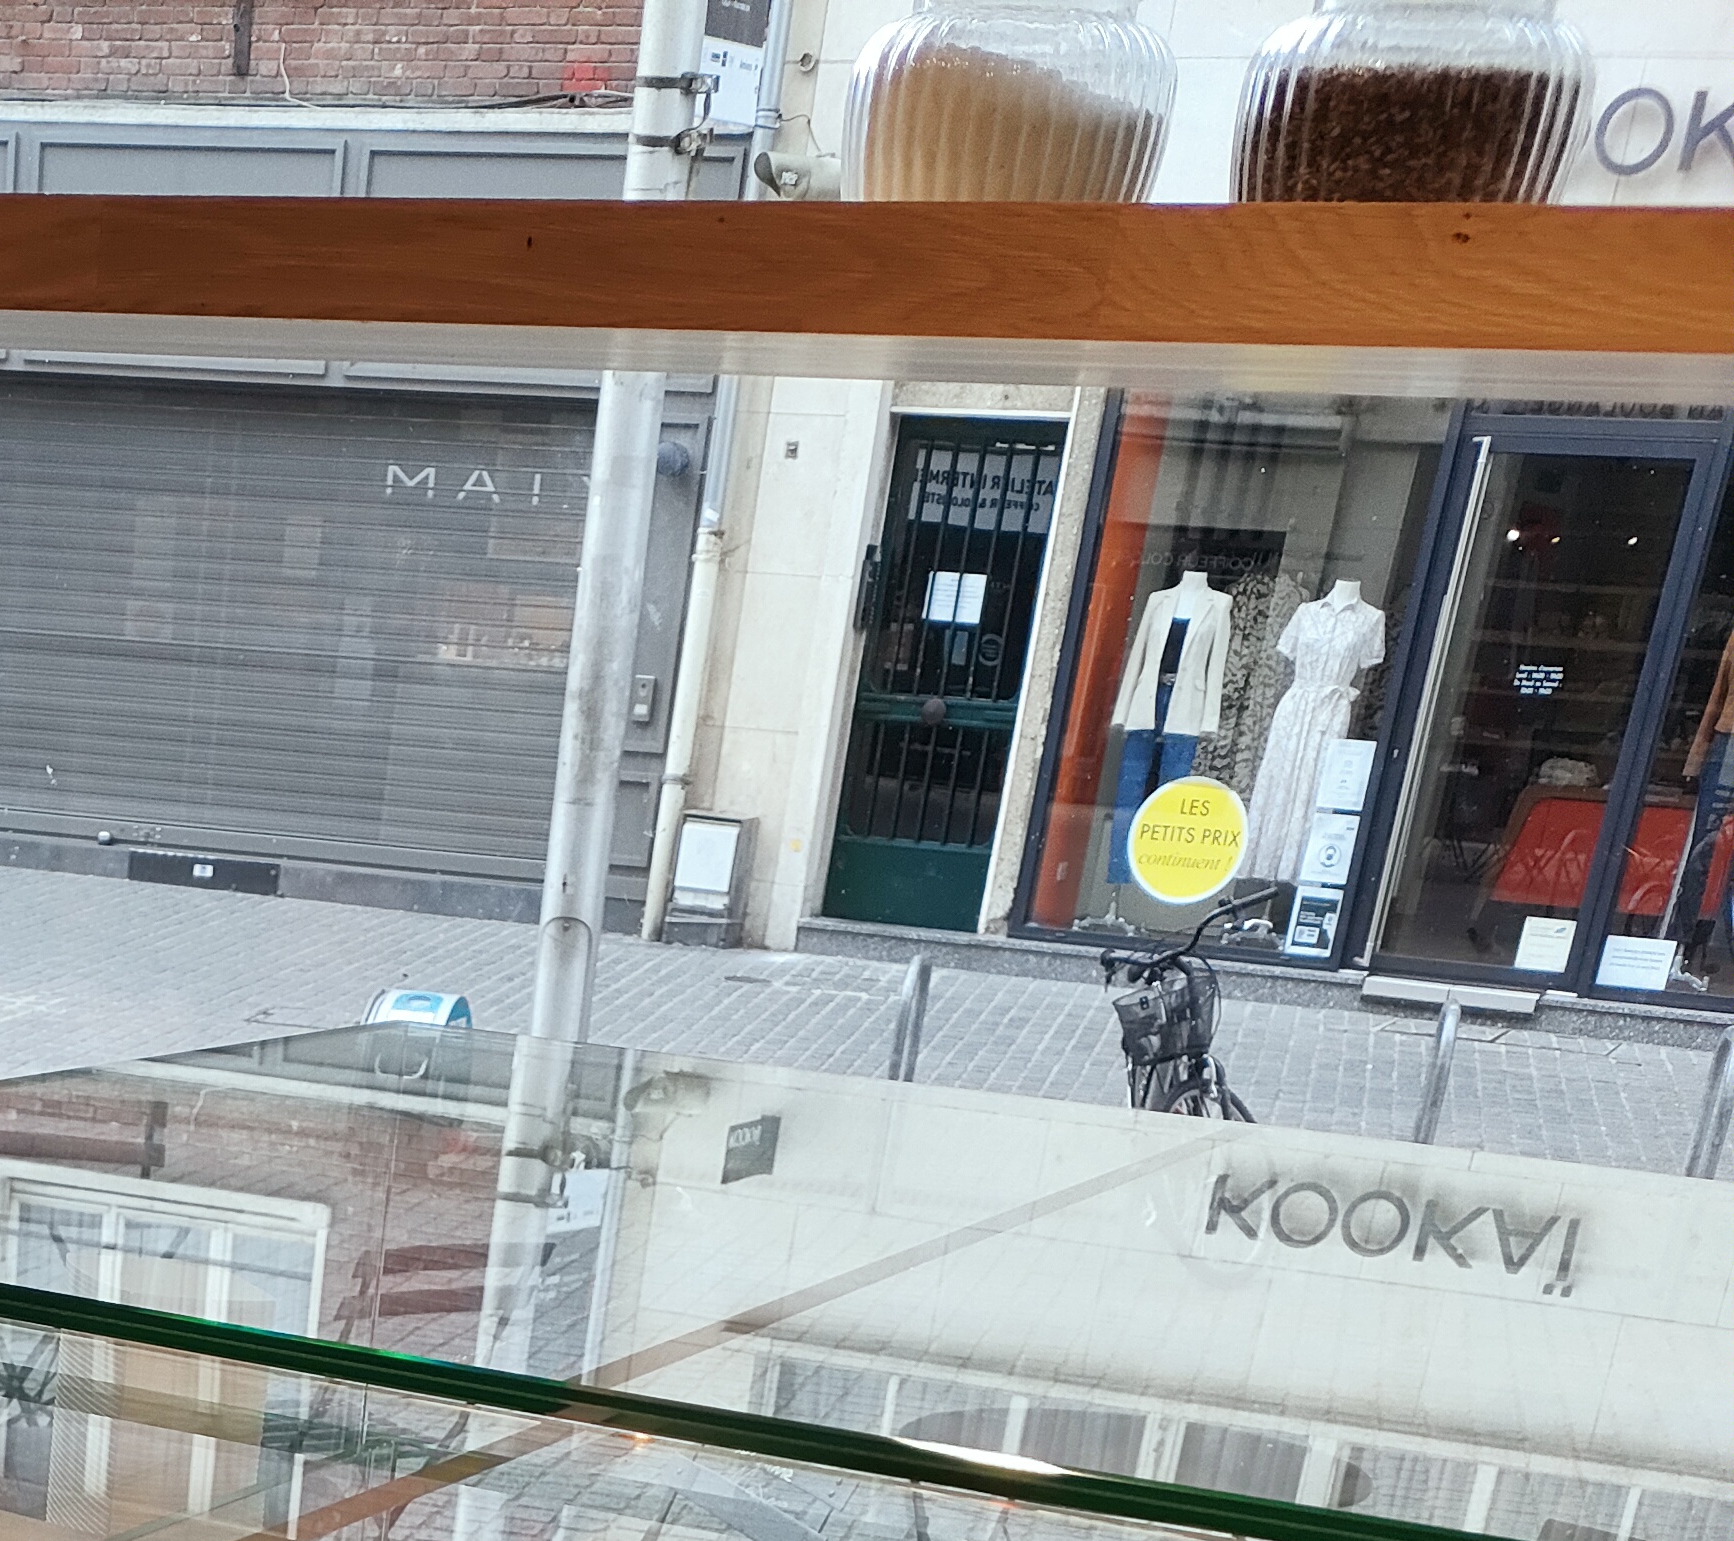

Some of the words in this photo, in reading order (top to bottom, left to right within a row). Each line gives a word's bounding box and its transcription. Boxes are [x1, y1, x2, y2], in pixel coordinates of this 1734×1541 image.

[385, 465, 590, 506] MAI
[1180, 798, 1211, 817] LES
[1139, 823, 1196, 844] PETITS
[1200, 828, 1241, 848] PRIX
[1138, 853, 1221, 870] continuent
